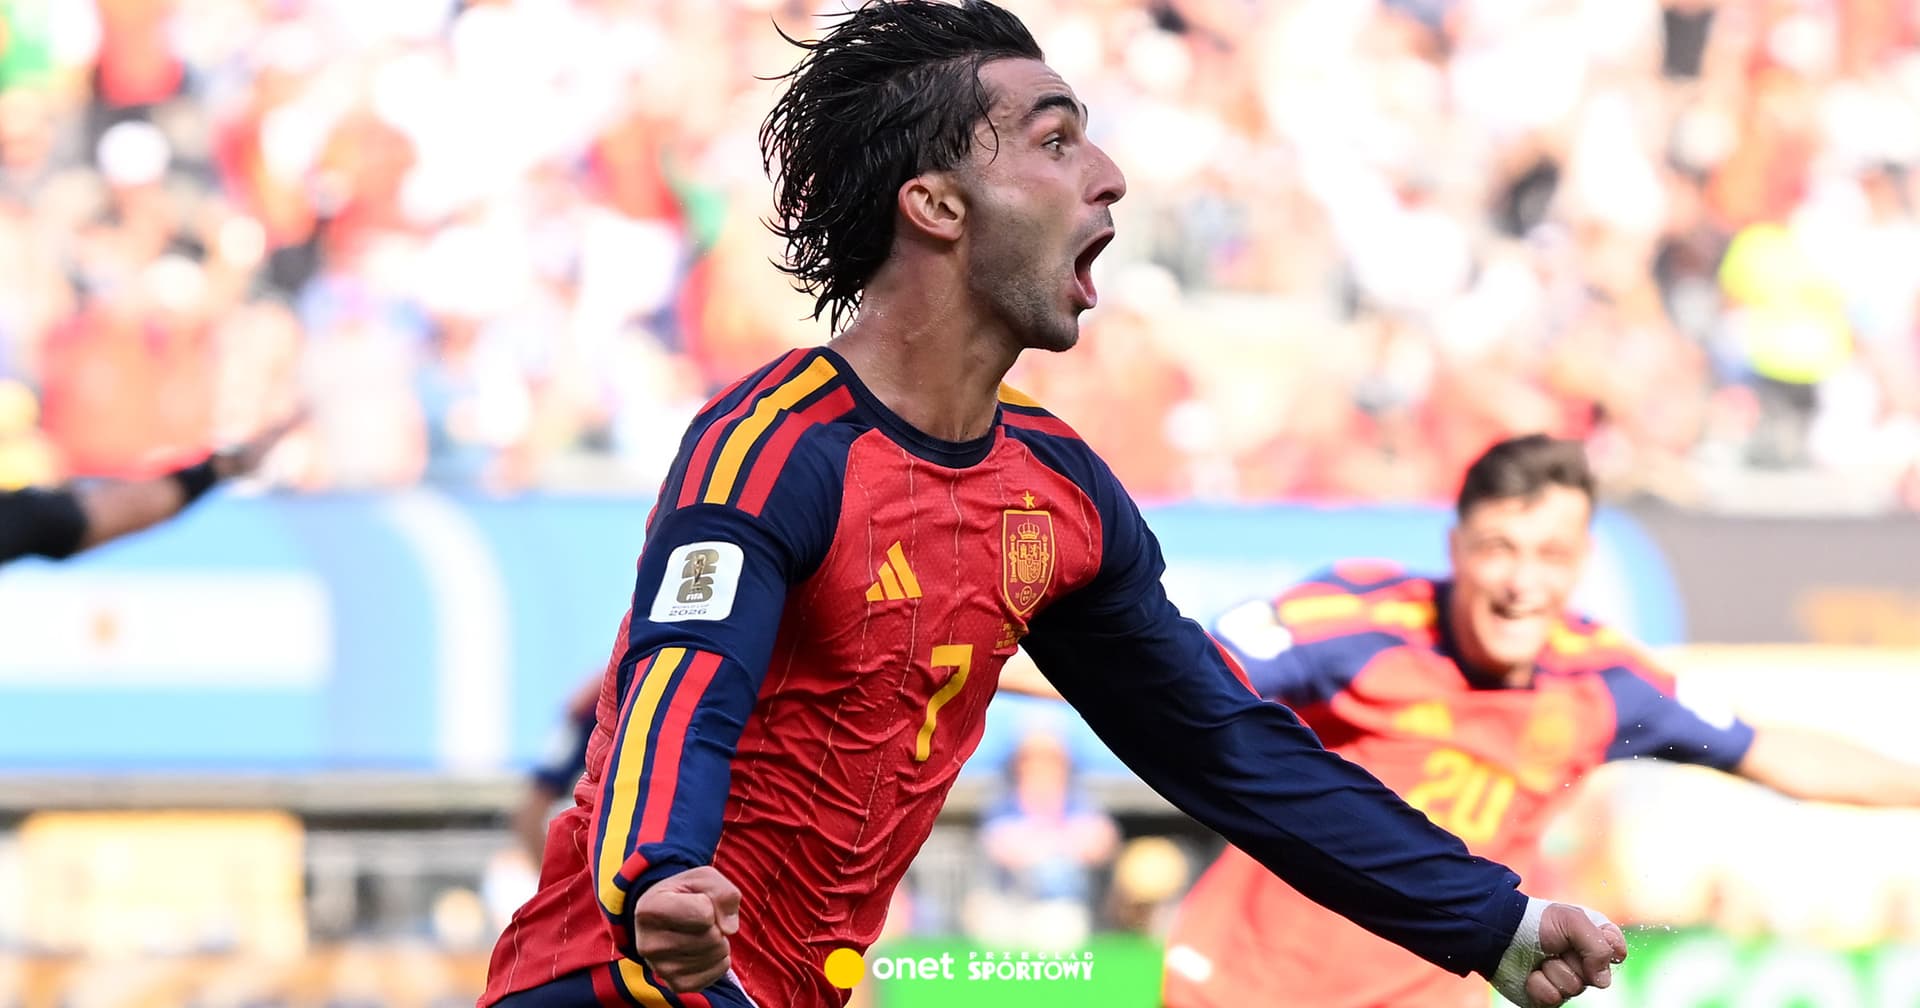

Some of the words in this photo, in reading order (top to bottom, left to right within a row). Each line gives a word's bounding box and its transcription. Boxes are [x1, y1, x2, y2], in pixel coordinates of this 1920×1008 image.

[668, 608, 707, 616] 2026
[915, 644, 973, 762] 7
[1404, 749, 1514, 844] 20
